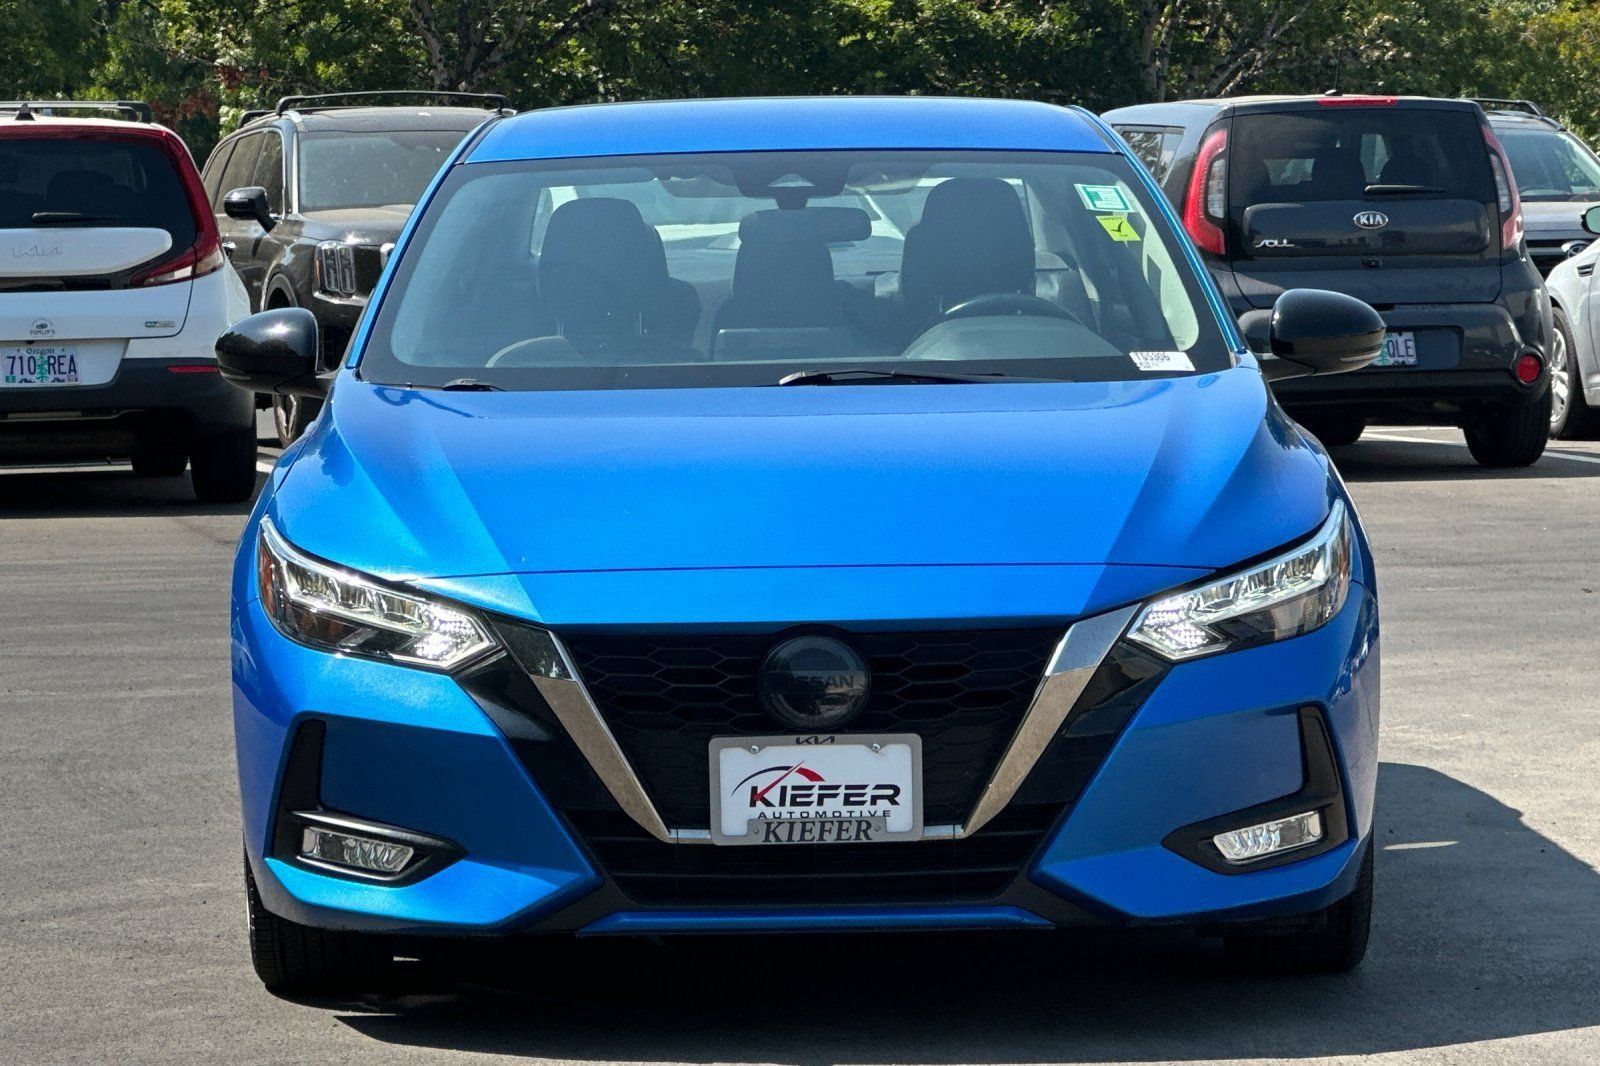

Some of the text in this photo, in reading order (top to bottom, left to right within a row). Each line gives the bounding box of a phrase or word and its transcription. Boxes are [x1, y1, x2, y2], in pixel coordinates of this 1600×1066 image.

[1359, 214, 1384, 225] KIA
[1255, 238, 1294, 248] SOUL
[26, 347, 55, 356] Oregon
[6, 355, 77, 375] 710 REA
[773, 673, 854, 688] SSAN
[795, 735, 835, 744] KIA
[749, 783, 901, 807] KIEFER
[757, 810, 891, 819] AUTOMOTIVE
[762, 820, 874, 843] KIEFER
